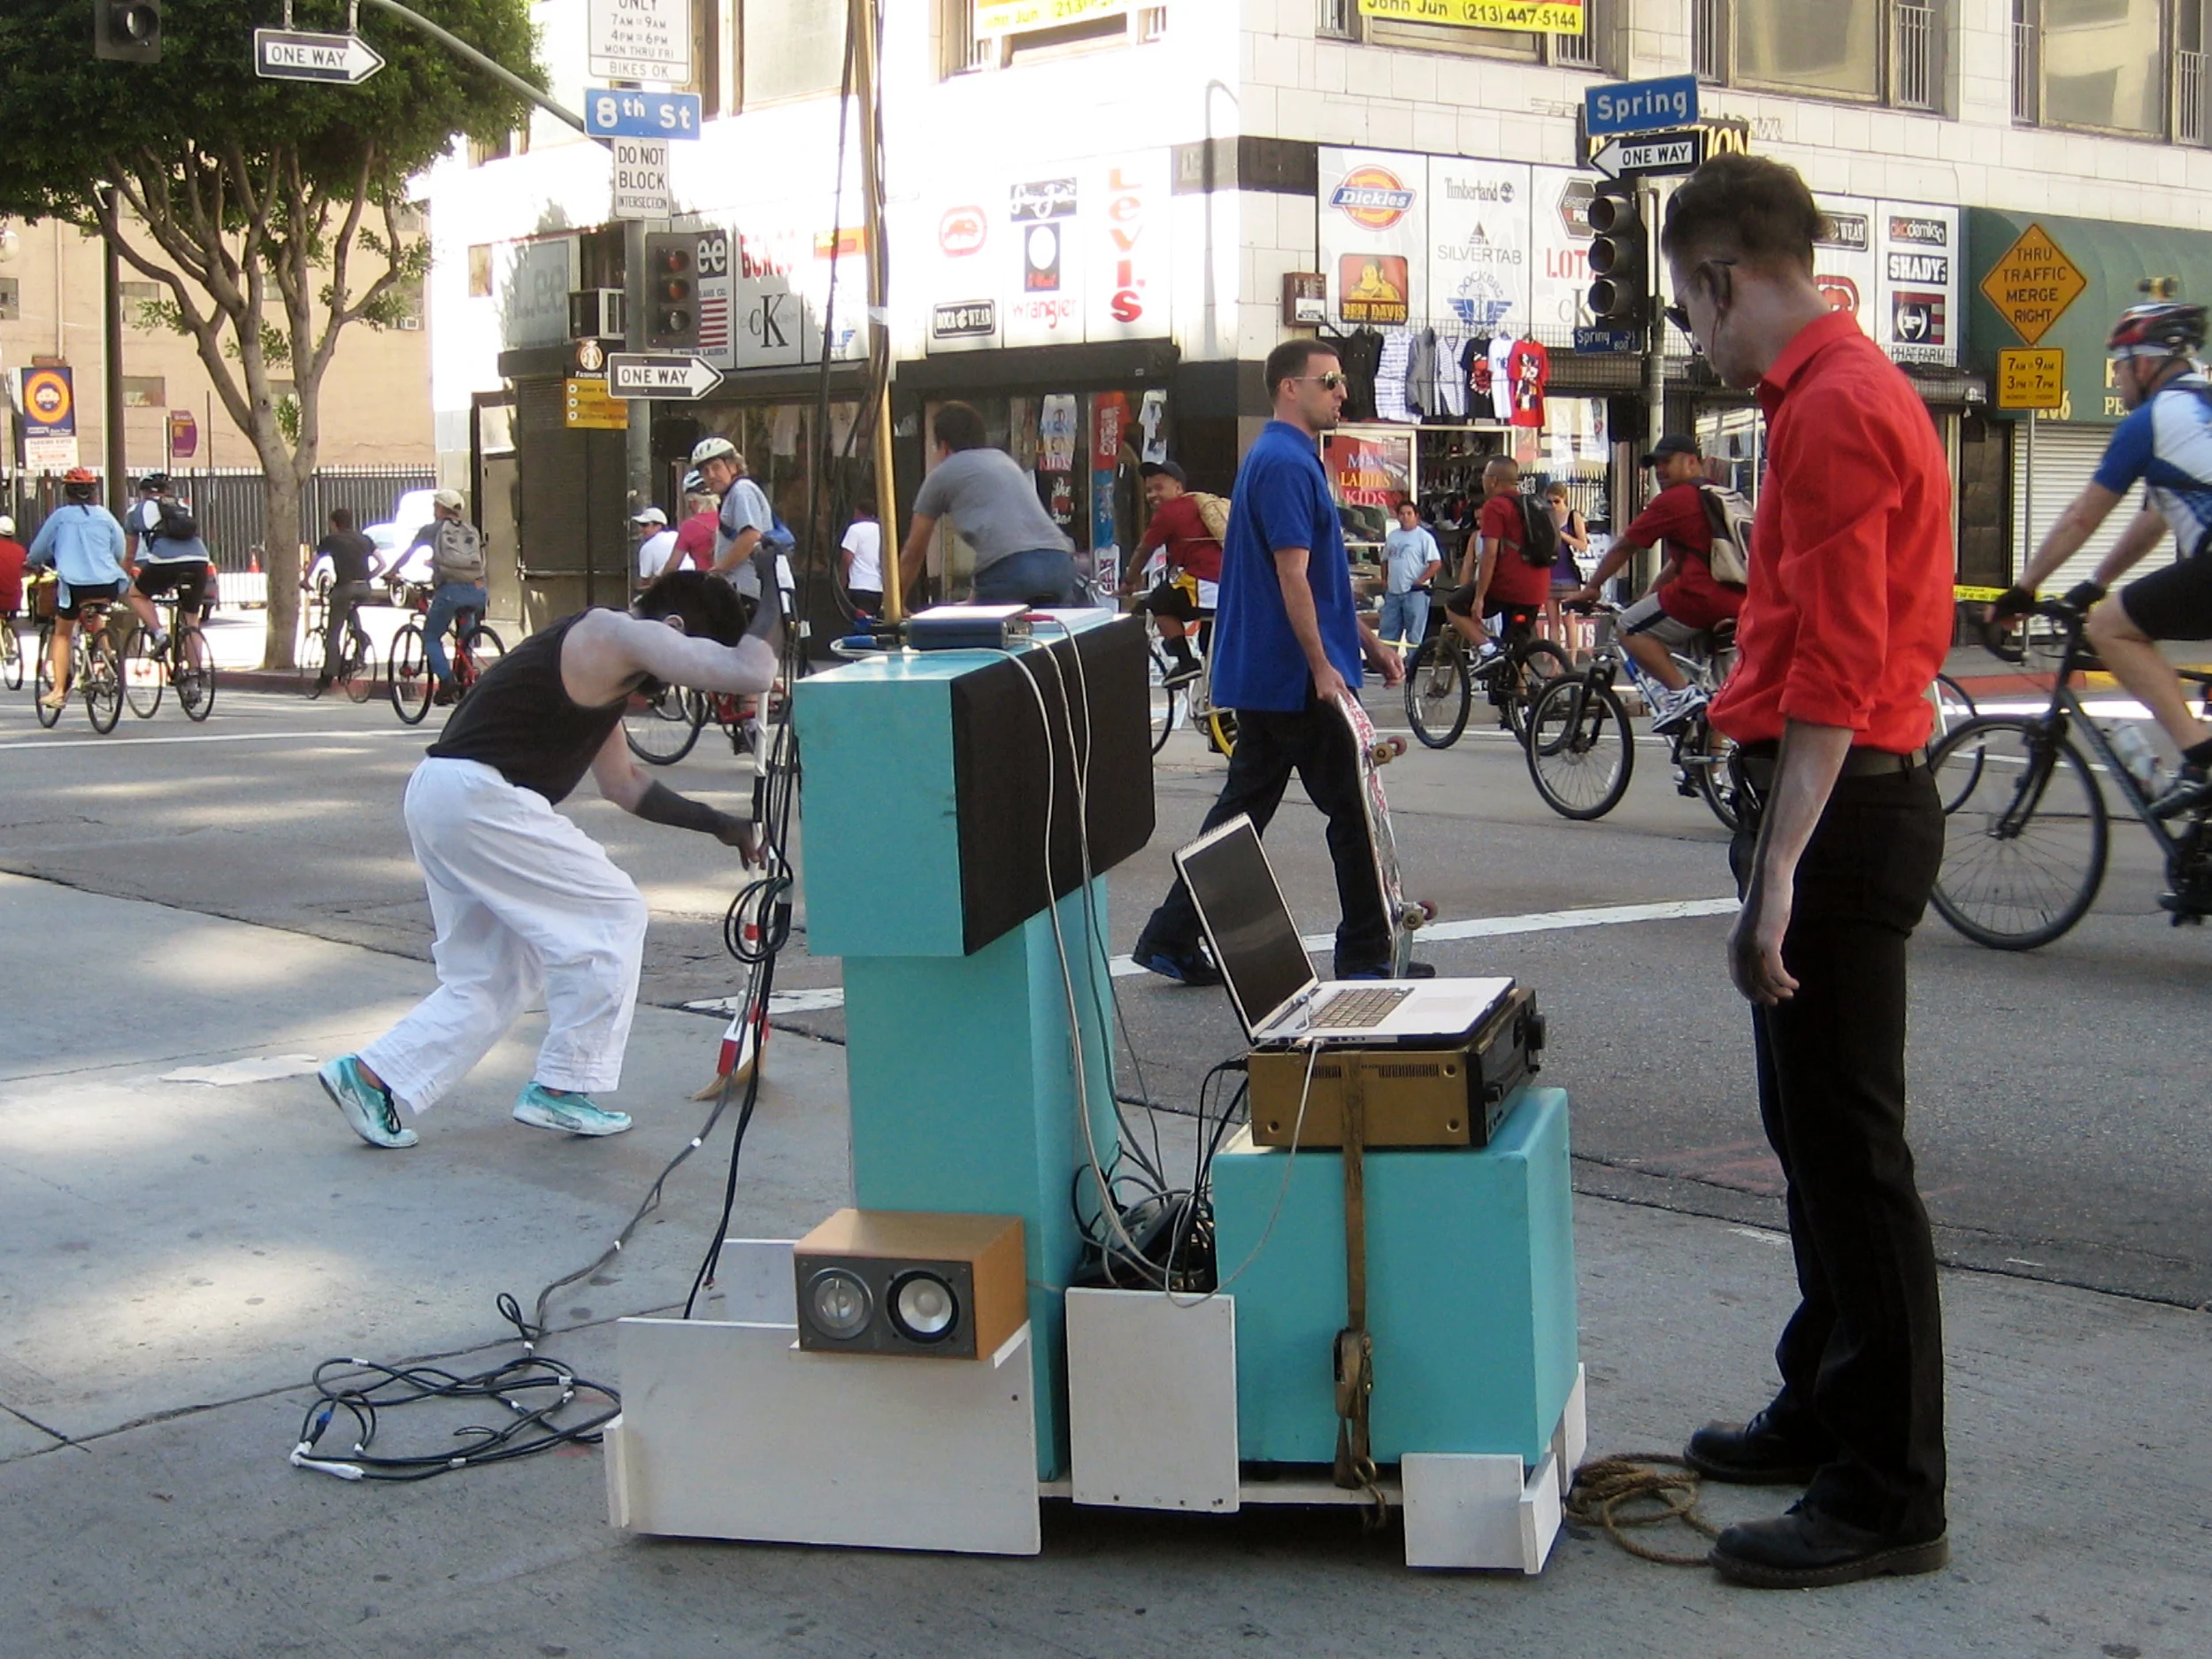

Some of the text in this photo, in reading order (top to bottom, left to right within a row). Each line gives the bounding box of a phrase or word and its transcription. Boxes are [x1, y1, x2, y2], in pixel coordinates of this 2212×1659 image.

[618, 0, 657, 11] ONLY
[1417, 0, 1448, 17] Jun
[1463, 4, 1503, 24] (213)
[1506, 9, 1577, 28] 447-5144
[271, 45, 347, 66] ONE WAY
[604, 44, 674, 59] MON THRU FRI
[609, 61, 670, 79] BIKES OK
[595, 96, 691, 129] 8th St
[1596, 89, 1688, 123] Spring
[618, 146, 665, 166] DO NOT
[1622, 143, 1689, 166] ONE WAY
[618, 171, 666, 190] BLOCK
[1445, 176, 1498, 203] Timberland
[617, 196, 668, 210] INTERSECTION
[1339, 189, 1407, 207] Dickies
[1839, 222, 1865, 243] WEAR
[1436, 244, 1523, 265] SILVERTAB
[2016, 247, 2053, 261] THRU
[1888, 255, 1940, 283] SHADY
[2003, 266, 2067, 282] TRAFFIC
[1457, 269, 1505, 299] DOCKERS
[2006, 288, 2058, 303] MERGE
[1371, 304, 1406, 322] DAVIS
[2013, 309, 2053, 323] RIGHT
[620, 368, 653, 384] ONE
[657, 368, 688, 384] WAY
[1346, 490, 1387, 506] KIDS
